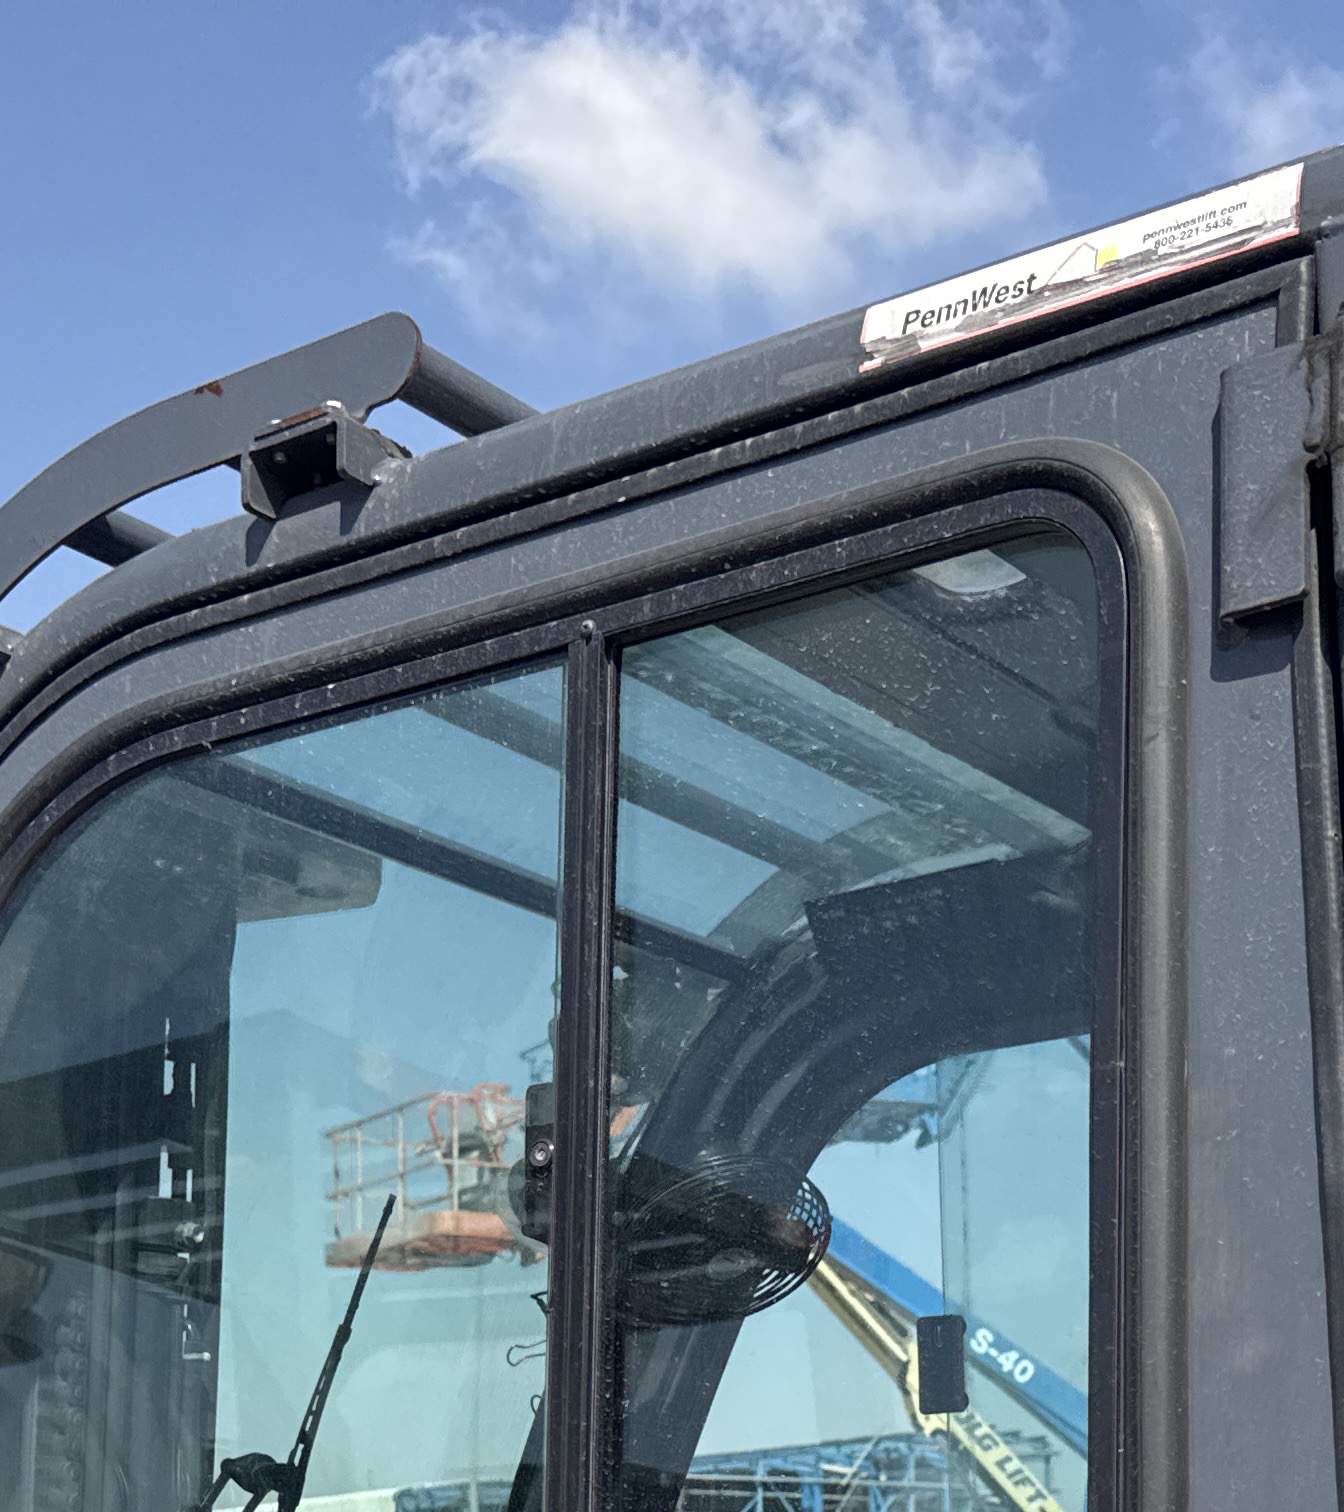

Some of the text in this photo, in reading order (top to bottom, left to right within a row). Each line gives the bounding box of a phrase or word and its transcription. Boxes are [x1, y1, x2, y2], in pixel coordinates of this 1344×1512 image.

[901, 273, 1037, 335] PennWest
[969, 1327, 1035, 1384] S-40
[956, 1409, 1000, 1453] JLG
